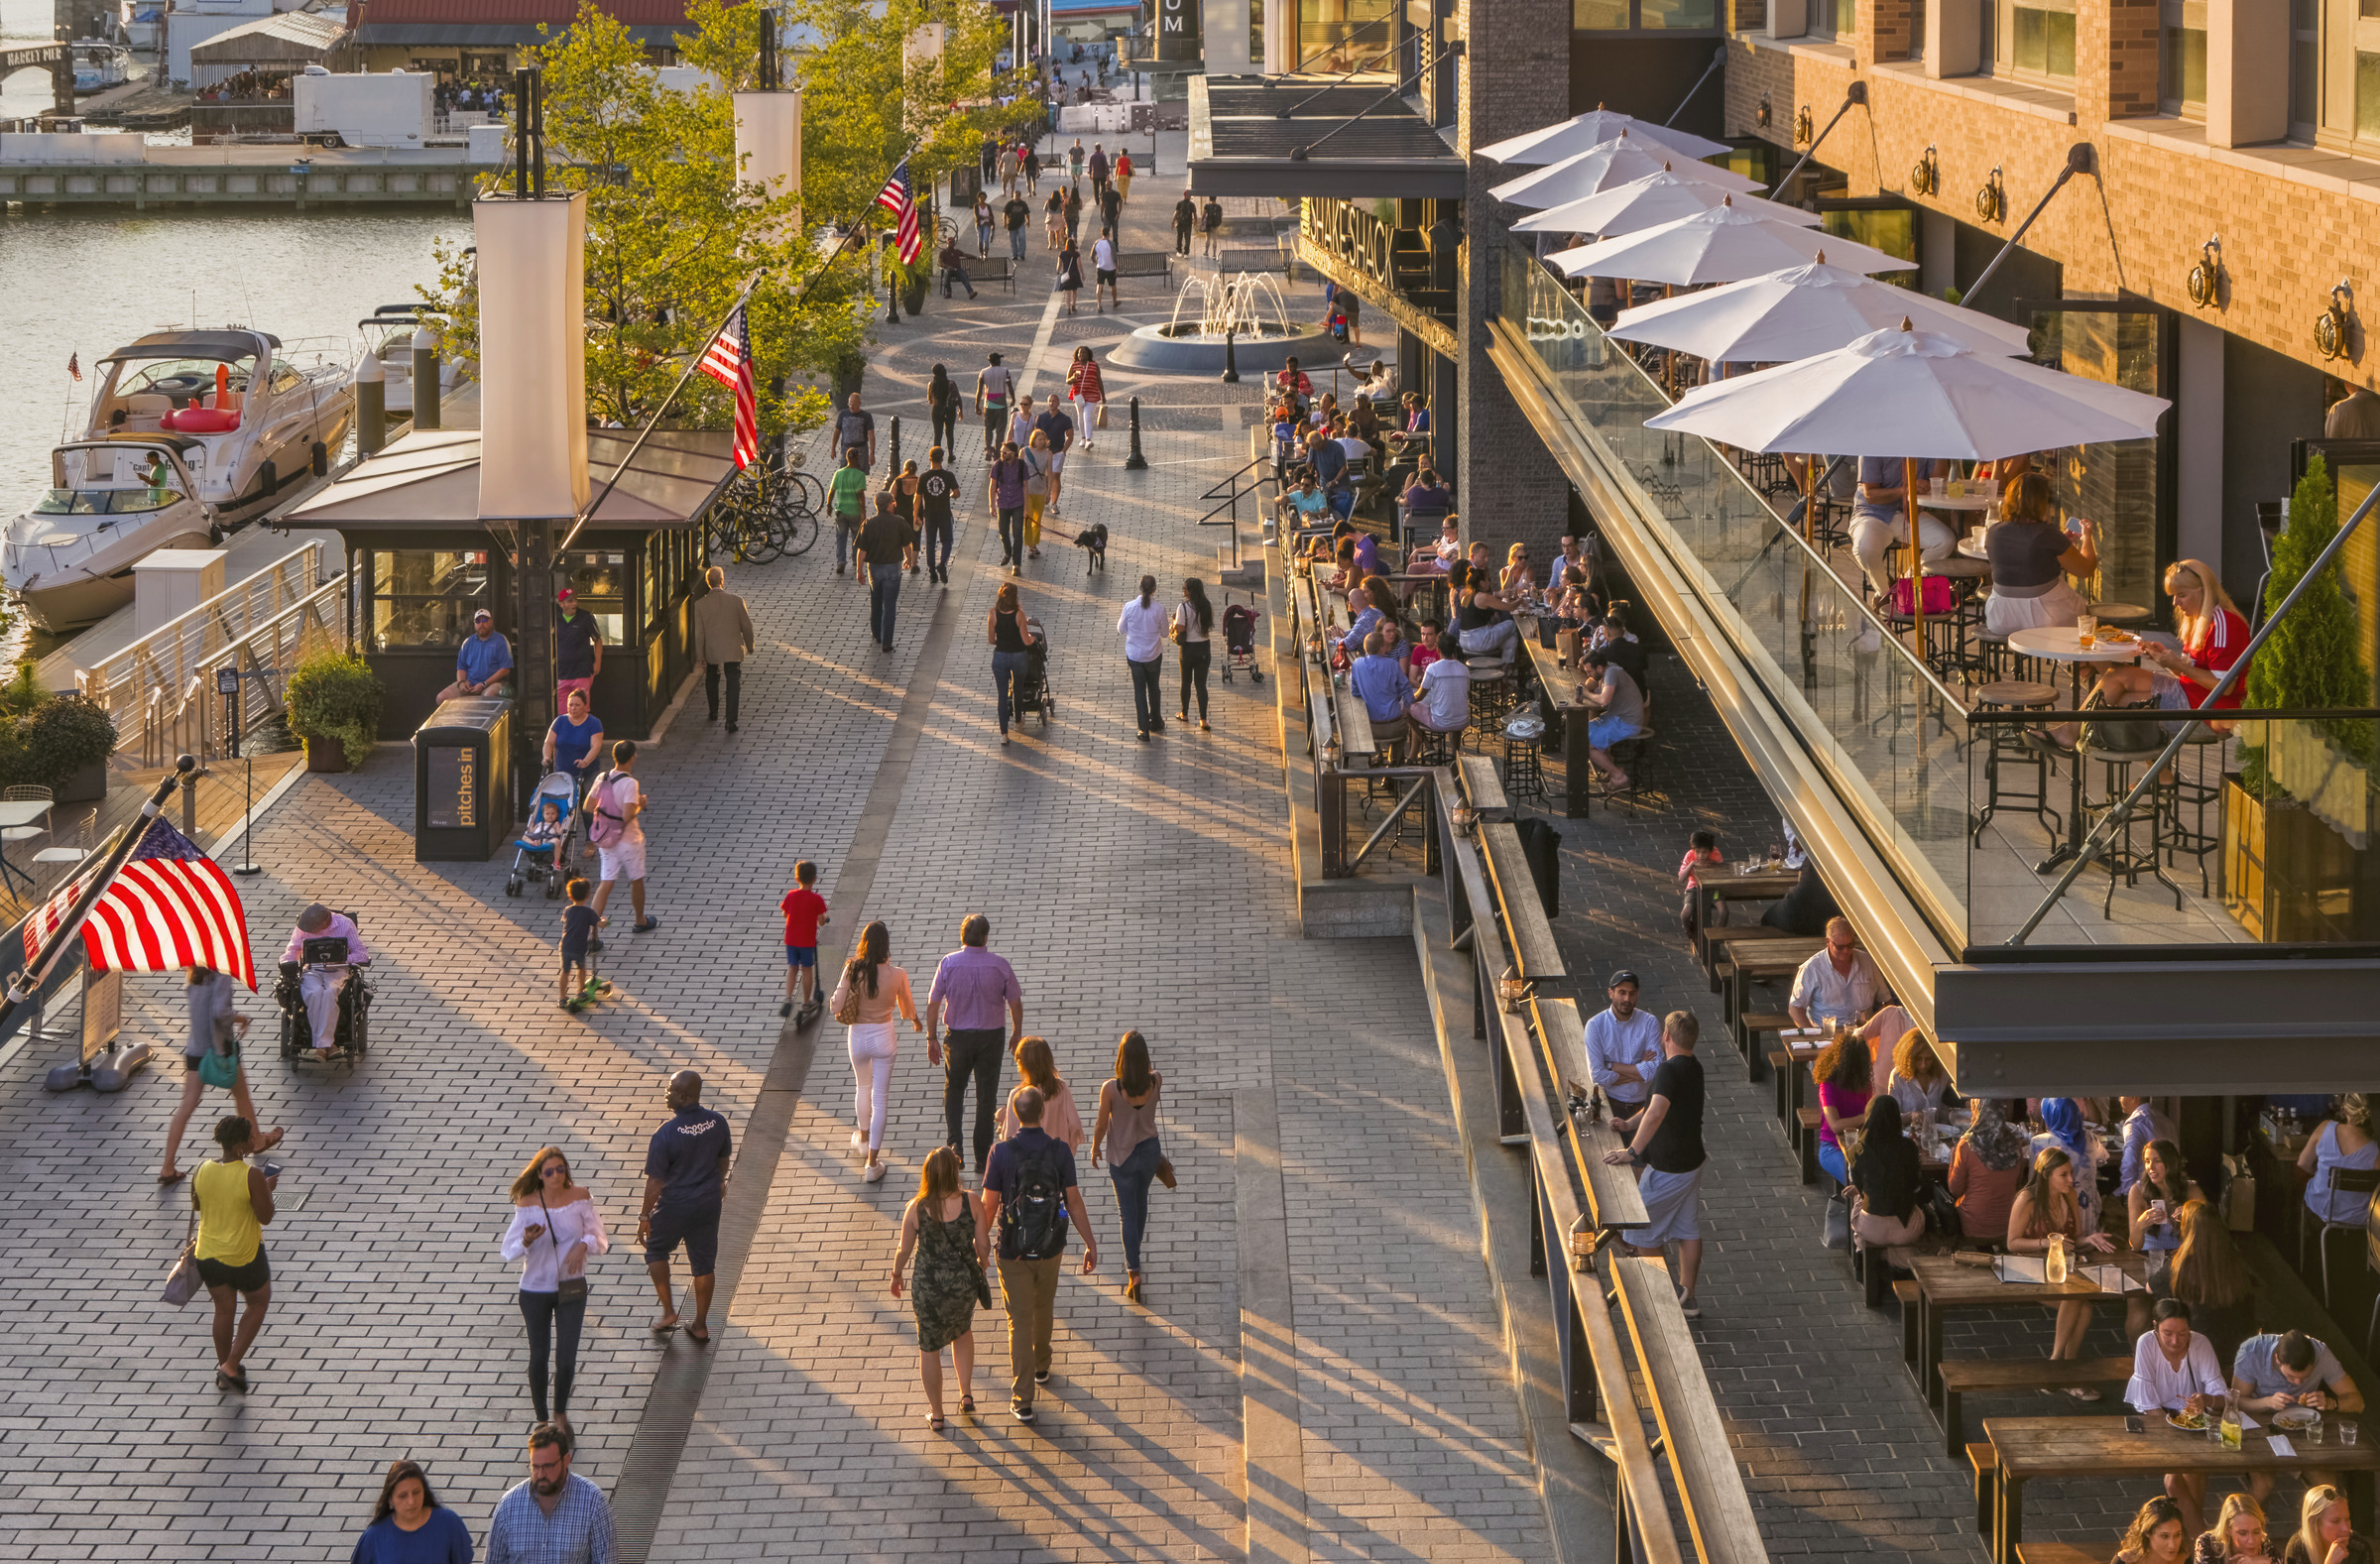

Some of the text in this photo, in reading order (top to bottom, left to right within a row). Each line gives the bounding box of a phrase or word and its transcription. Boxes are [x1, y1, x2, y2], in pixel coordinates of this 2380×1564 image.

[7, 47, 61, 66] MARKET PIER
[1349, 205, 1394, 290] SHACK
[457, 748, 476, 826] pitches in
